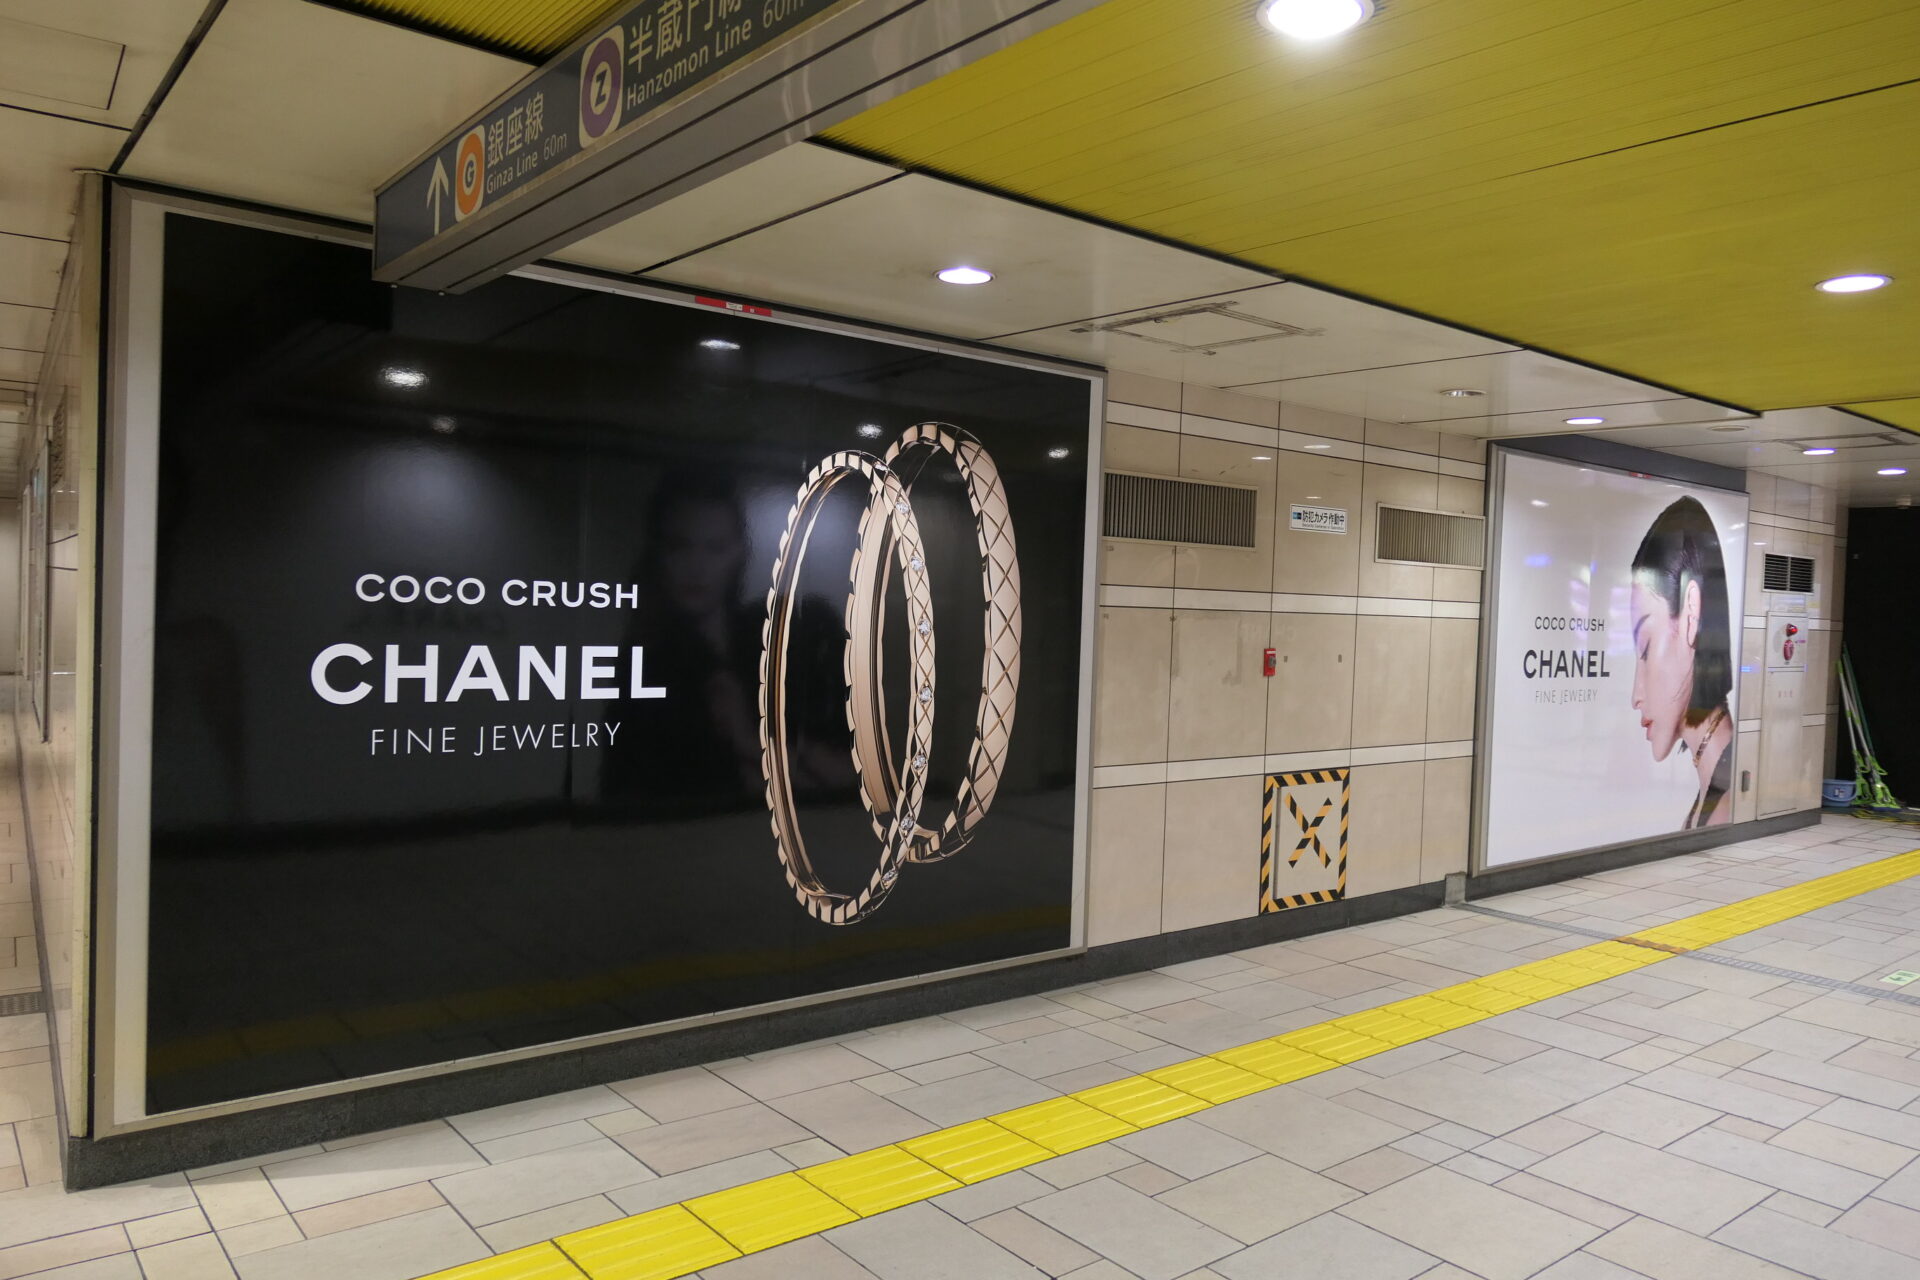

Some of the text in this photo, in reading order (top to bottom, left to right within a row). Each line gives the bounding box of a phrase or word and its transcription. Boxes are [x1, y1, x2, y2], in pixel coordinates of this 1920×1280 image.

[626, 44, 709, 110] Hanzomon
[715, 18, 752, 58] Line
[594, 71, 608, 108] Z
[487, 91, 544, 169] 銀座線
[465, 159, 475, 188] G
[486, 133, 568, 194] Ginza Line 60m
[355, 573, 638, 609] COCO CRUSH
[1534, 616, 1605, 632] COCO CRUSH
[310, 643, 667, 705] CHANEL
[1523, 649, 1610, 679] CHANEL
[1535, 689, 1598, 705] FINE JEWELRY
[371, 721, 621, 757] FINE JEWELRY
